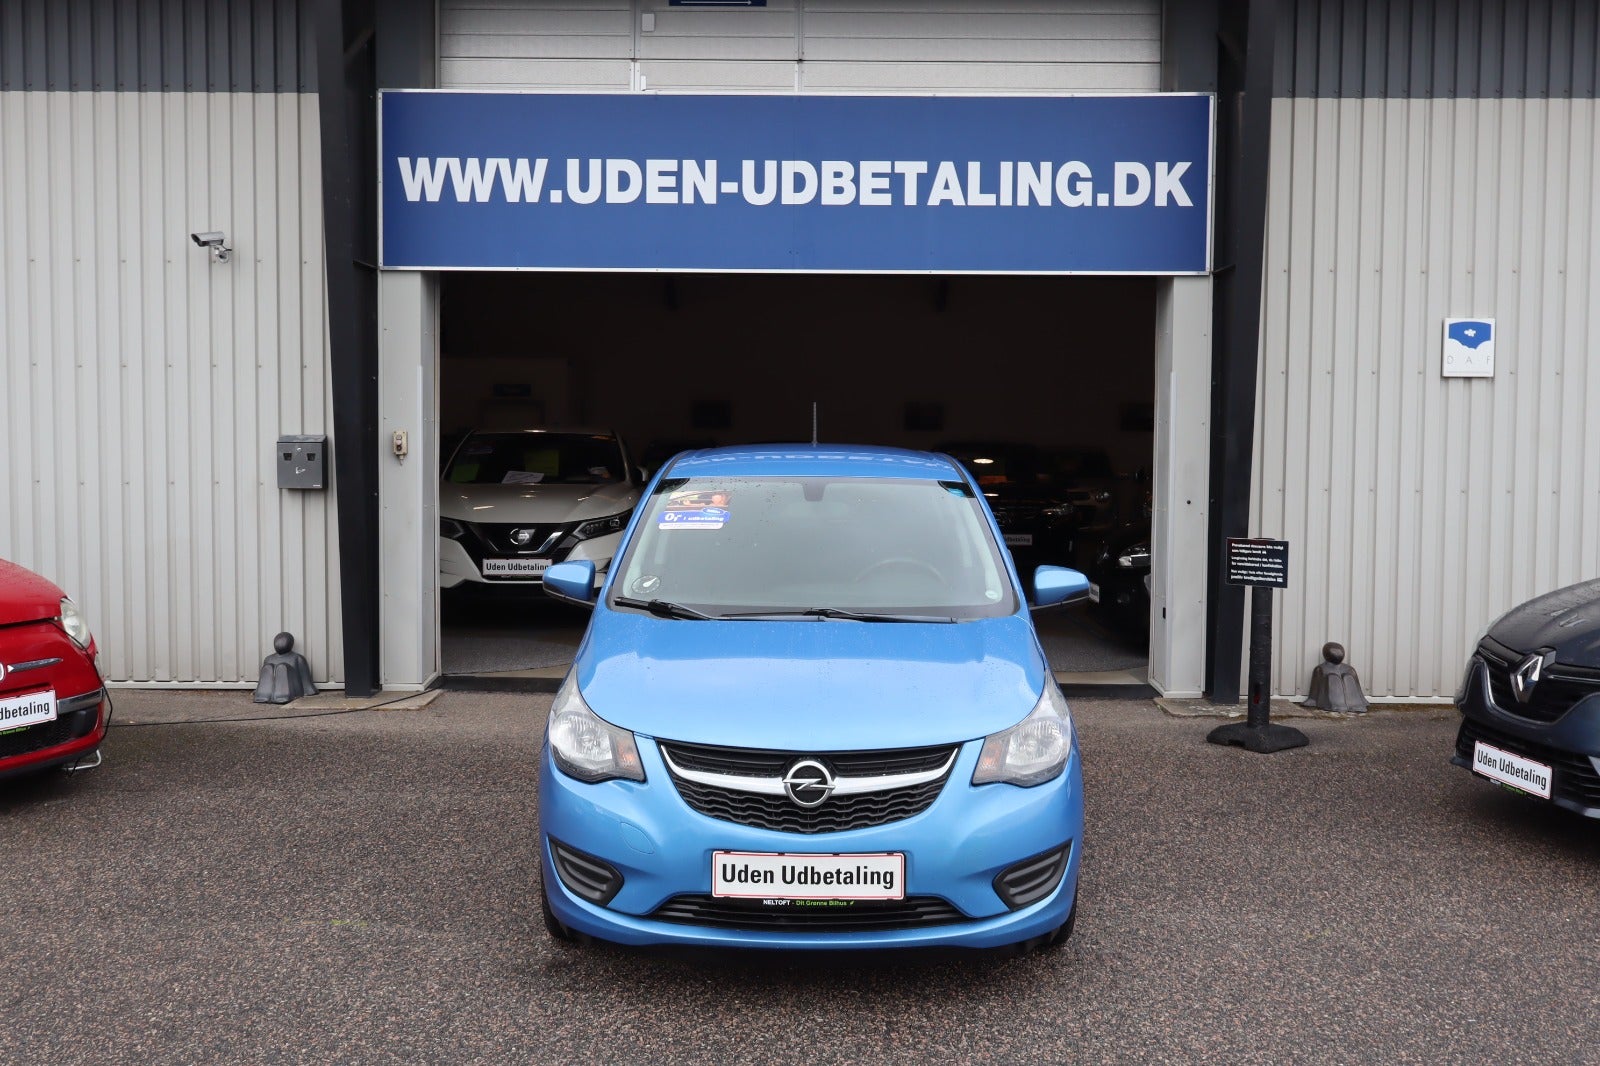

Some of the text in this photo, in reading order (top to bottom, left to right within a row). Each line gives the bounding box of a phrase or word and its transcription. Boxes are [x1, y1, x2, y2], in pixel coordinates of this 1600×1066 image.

[397, 157, 1194, 208] WWW.UDEN-UDBETALING.DK
[486, 563, 506, 571] Uden
[0, 701, 50, 720] dbetaling
[1477, 749, 1497, 769] Uden
[1499, 757, 1547, 791] Udbetaling
[722, 863, 894, 890] Uden Udbetaling
